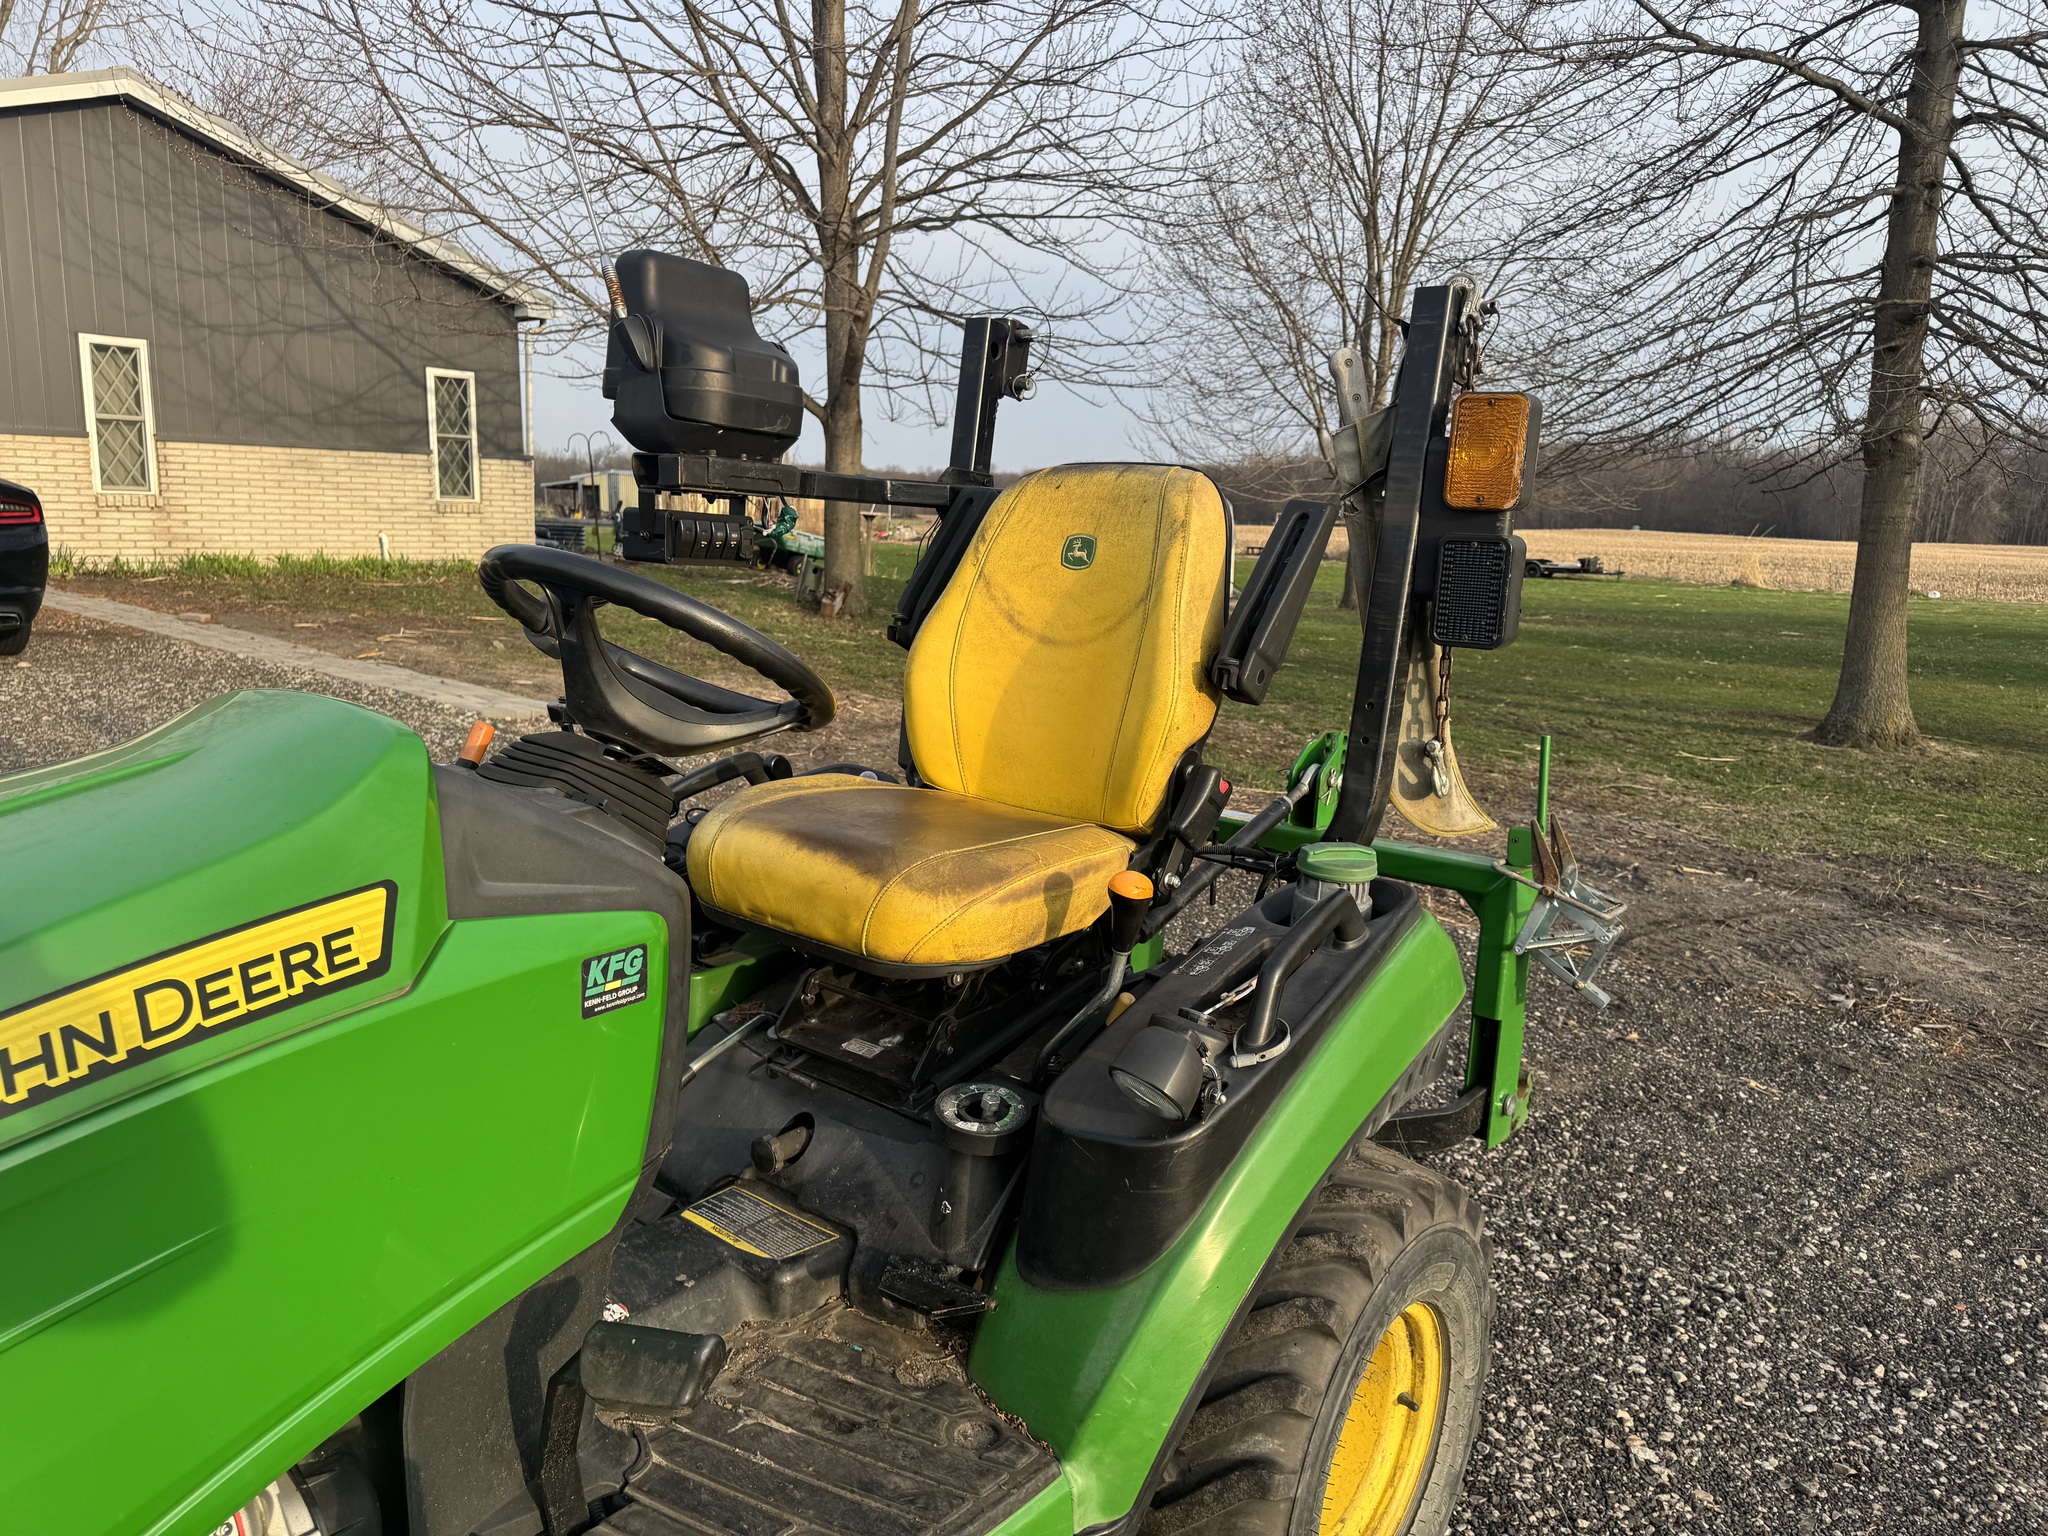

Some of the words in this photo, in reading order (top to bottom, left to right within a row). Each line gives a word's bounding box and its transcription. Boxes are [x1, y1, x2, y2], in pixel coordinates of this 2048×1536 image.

[133, 926, 361, 1044] DEERE
[586, 948, 644, 988] KFG
[584, 992, 617, 1009] KENN-FELD
[617, 985, 638, 998] GROUP
